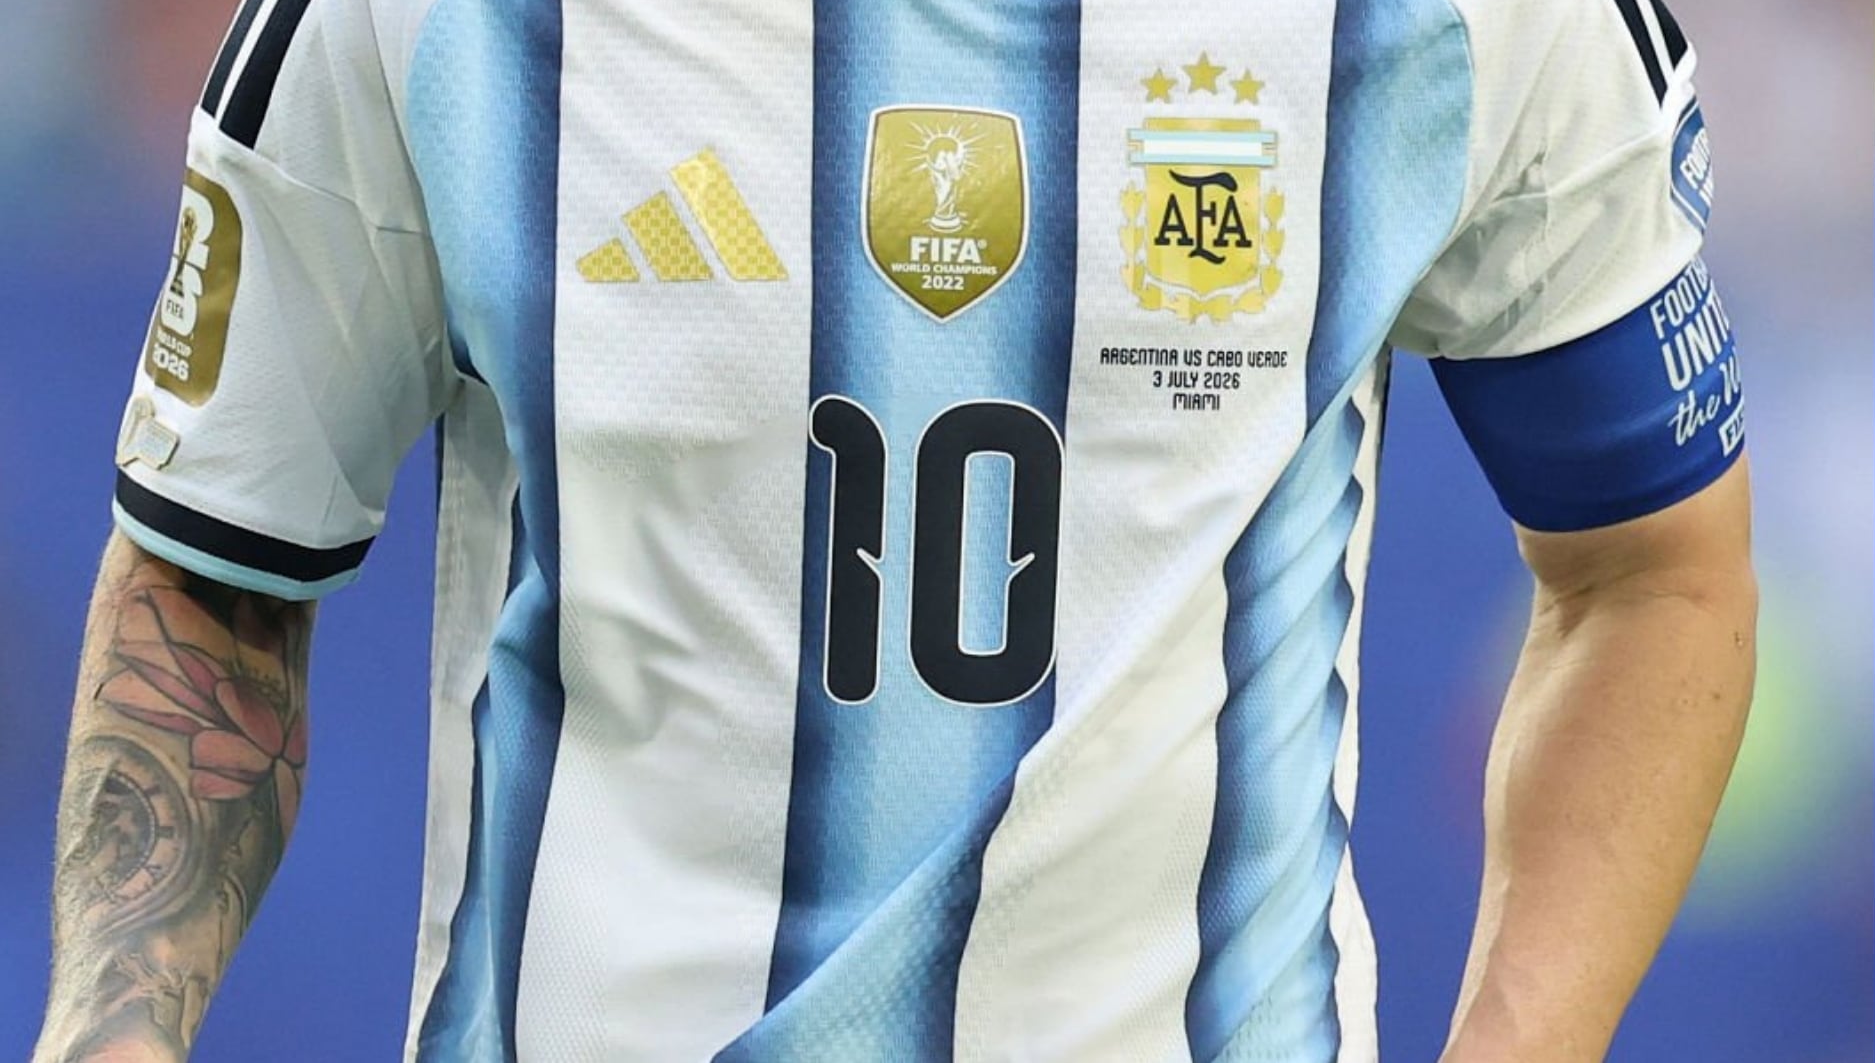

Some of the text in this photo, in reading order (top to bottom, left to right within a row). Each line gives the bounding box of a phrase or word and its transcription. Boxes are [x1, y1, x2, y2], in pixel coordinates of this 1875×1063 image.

[1153, 168, 1253, 265] AFA
[911, 236, 981, 264] FIFA
[891, 263, 998, 276] WORLD CHAMPIONS
[921, 275, 965, 291] 2022
[1650, 253, 1709, 340] FOOTB
[1662, 279, 1730, 392] UNIT
[1101, 348, 1288, 369] ARGENTINA VS CABO VERDE
[1153, 370, 1241, 390] 3 JULY 2026
[1172, 392, 1221, 411] MIAMI
[1668, 390, 1721, 447] the
[808, 394, 1067, 708] 10
